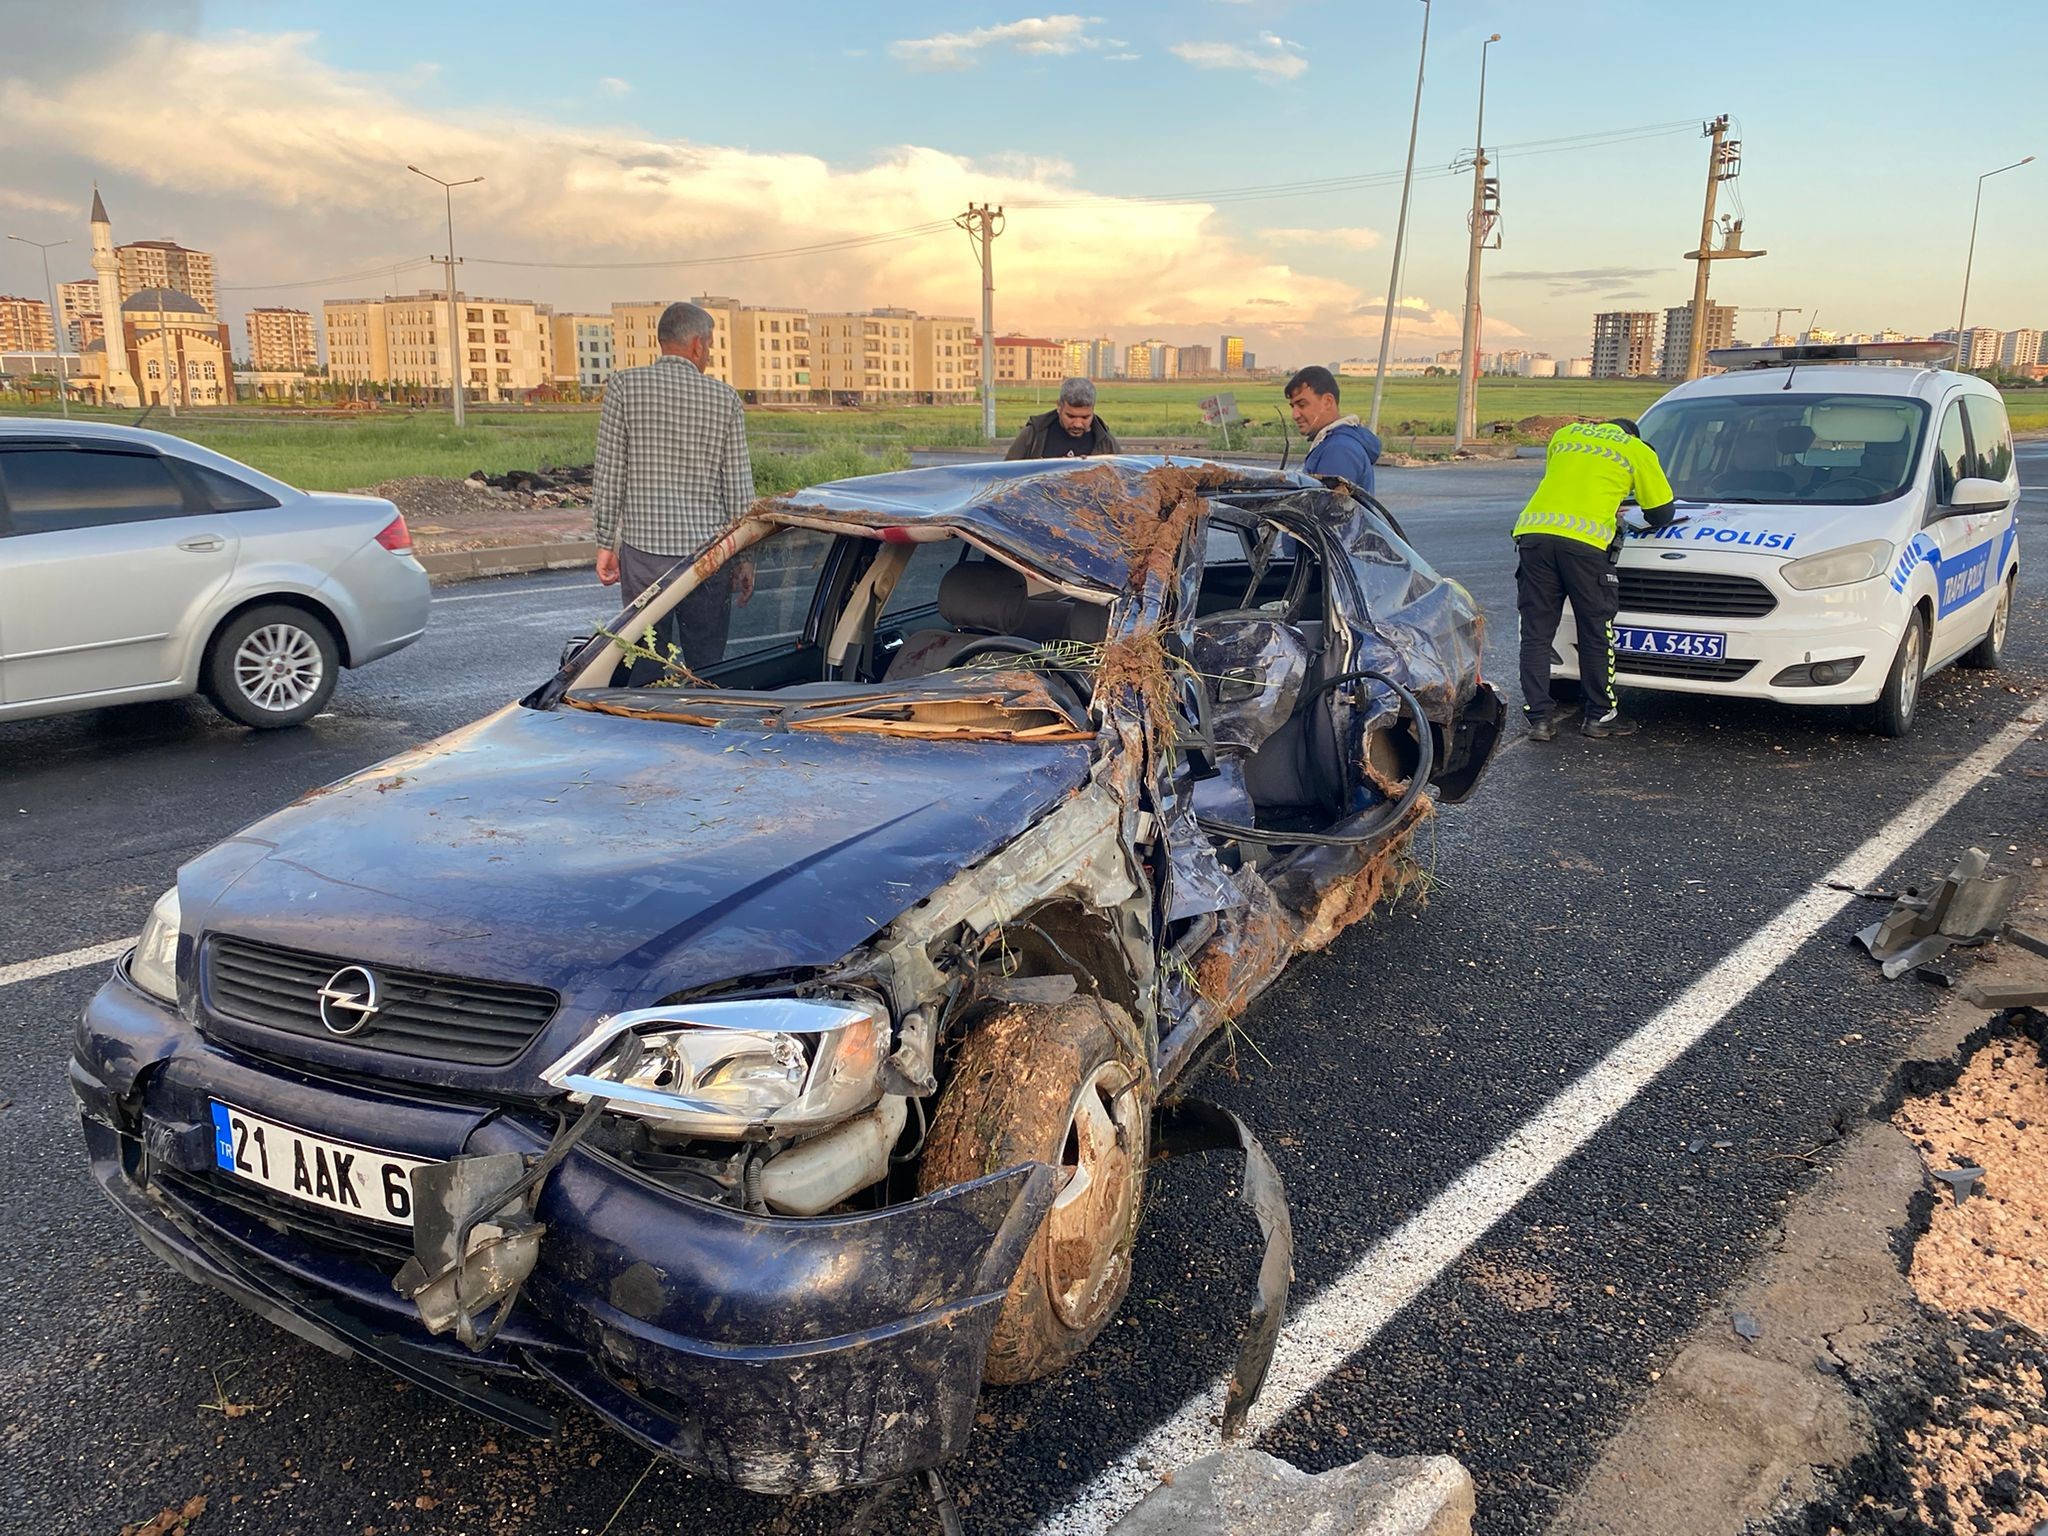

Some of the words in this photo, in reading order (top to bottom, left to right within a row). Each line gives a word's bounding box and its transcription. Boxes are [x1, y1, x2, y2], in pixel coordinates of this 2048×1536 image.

[1694, 526, 1797, 551] POLİSİ
[1612, 630, 1634, 649] 21
[1640, 633, 1658, 652] A
[1664, 635, 1721, 657] 5455
[219, 1140, 233, 1159] TR
[232, 1118, 269, 1180] 21
[294, 1139, 362, 1209] AAK
[381, 1163, 413, 1218] 6
